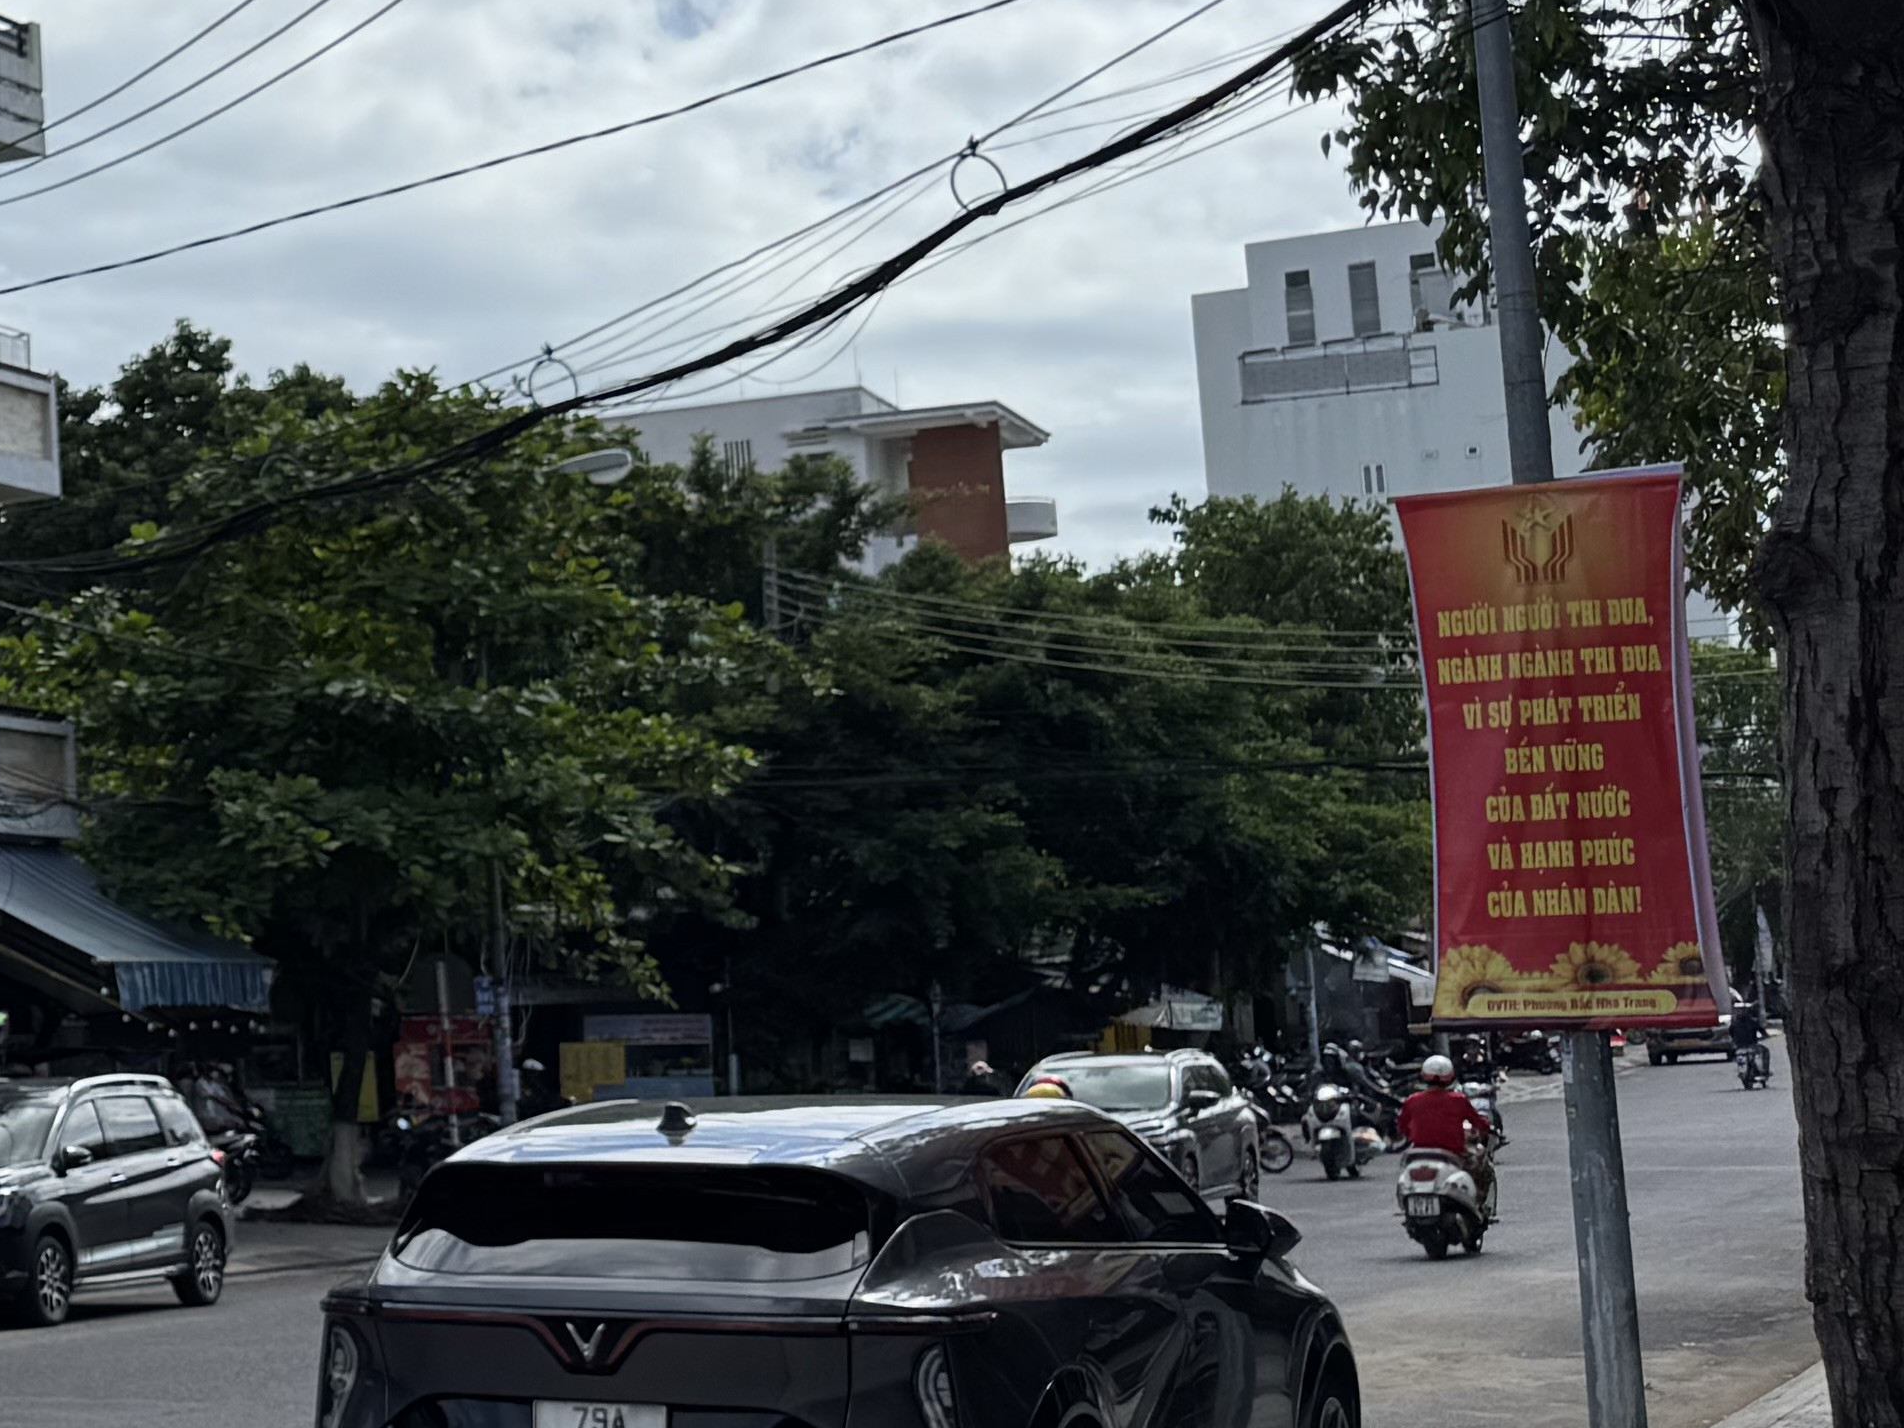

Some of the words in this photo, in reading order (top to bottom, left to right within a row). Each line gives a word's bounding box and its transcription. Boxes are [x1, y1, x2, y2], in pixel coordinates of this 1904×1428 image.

[1437, 601, 1498, 638] NGƯỜI
[1502, 596, 1562, 633] NGƯỜI
[1567, 599, 1602, 628] THI
[1437, 648, 1504, 685] NGÀNH
[1508, 643, 1574, 679] NGÀNH
[1580, 647, 1616, 675] THI
[1519, 689, 1573, 726] PHÁT
[1578, 681, 1642, 723] TRIỂN
[1485, 785, 1526, 823] CỦA
[1487, 835, 1515, 871] VÀ
[1520, 839, 1575, 875] HẠNH
[1580, 830, 1636, 868] PHÚC
[1487, 880, 1528, 919] CỦA
[1532, 881, 1587, 917] NHÂN
